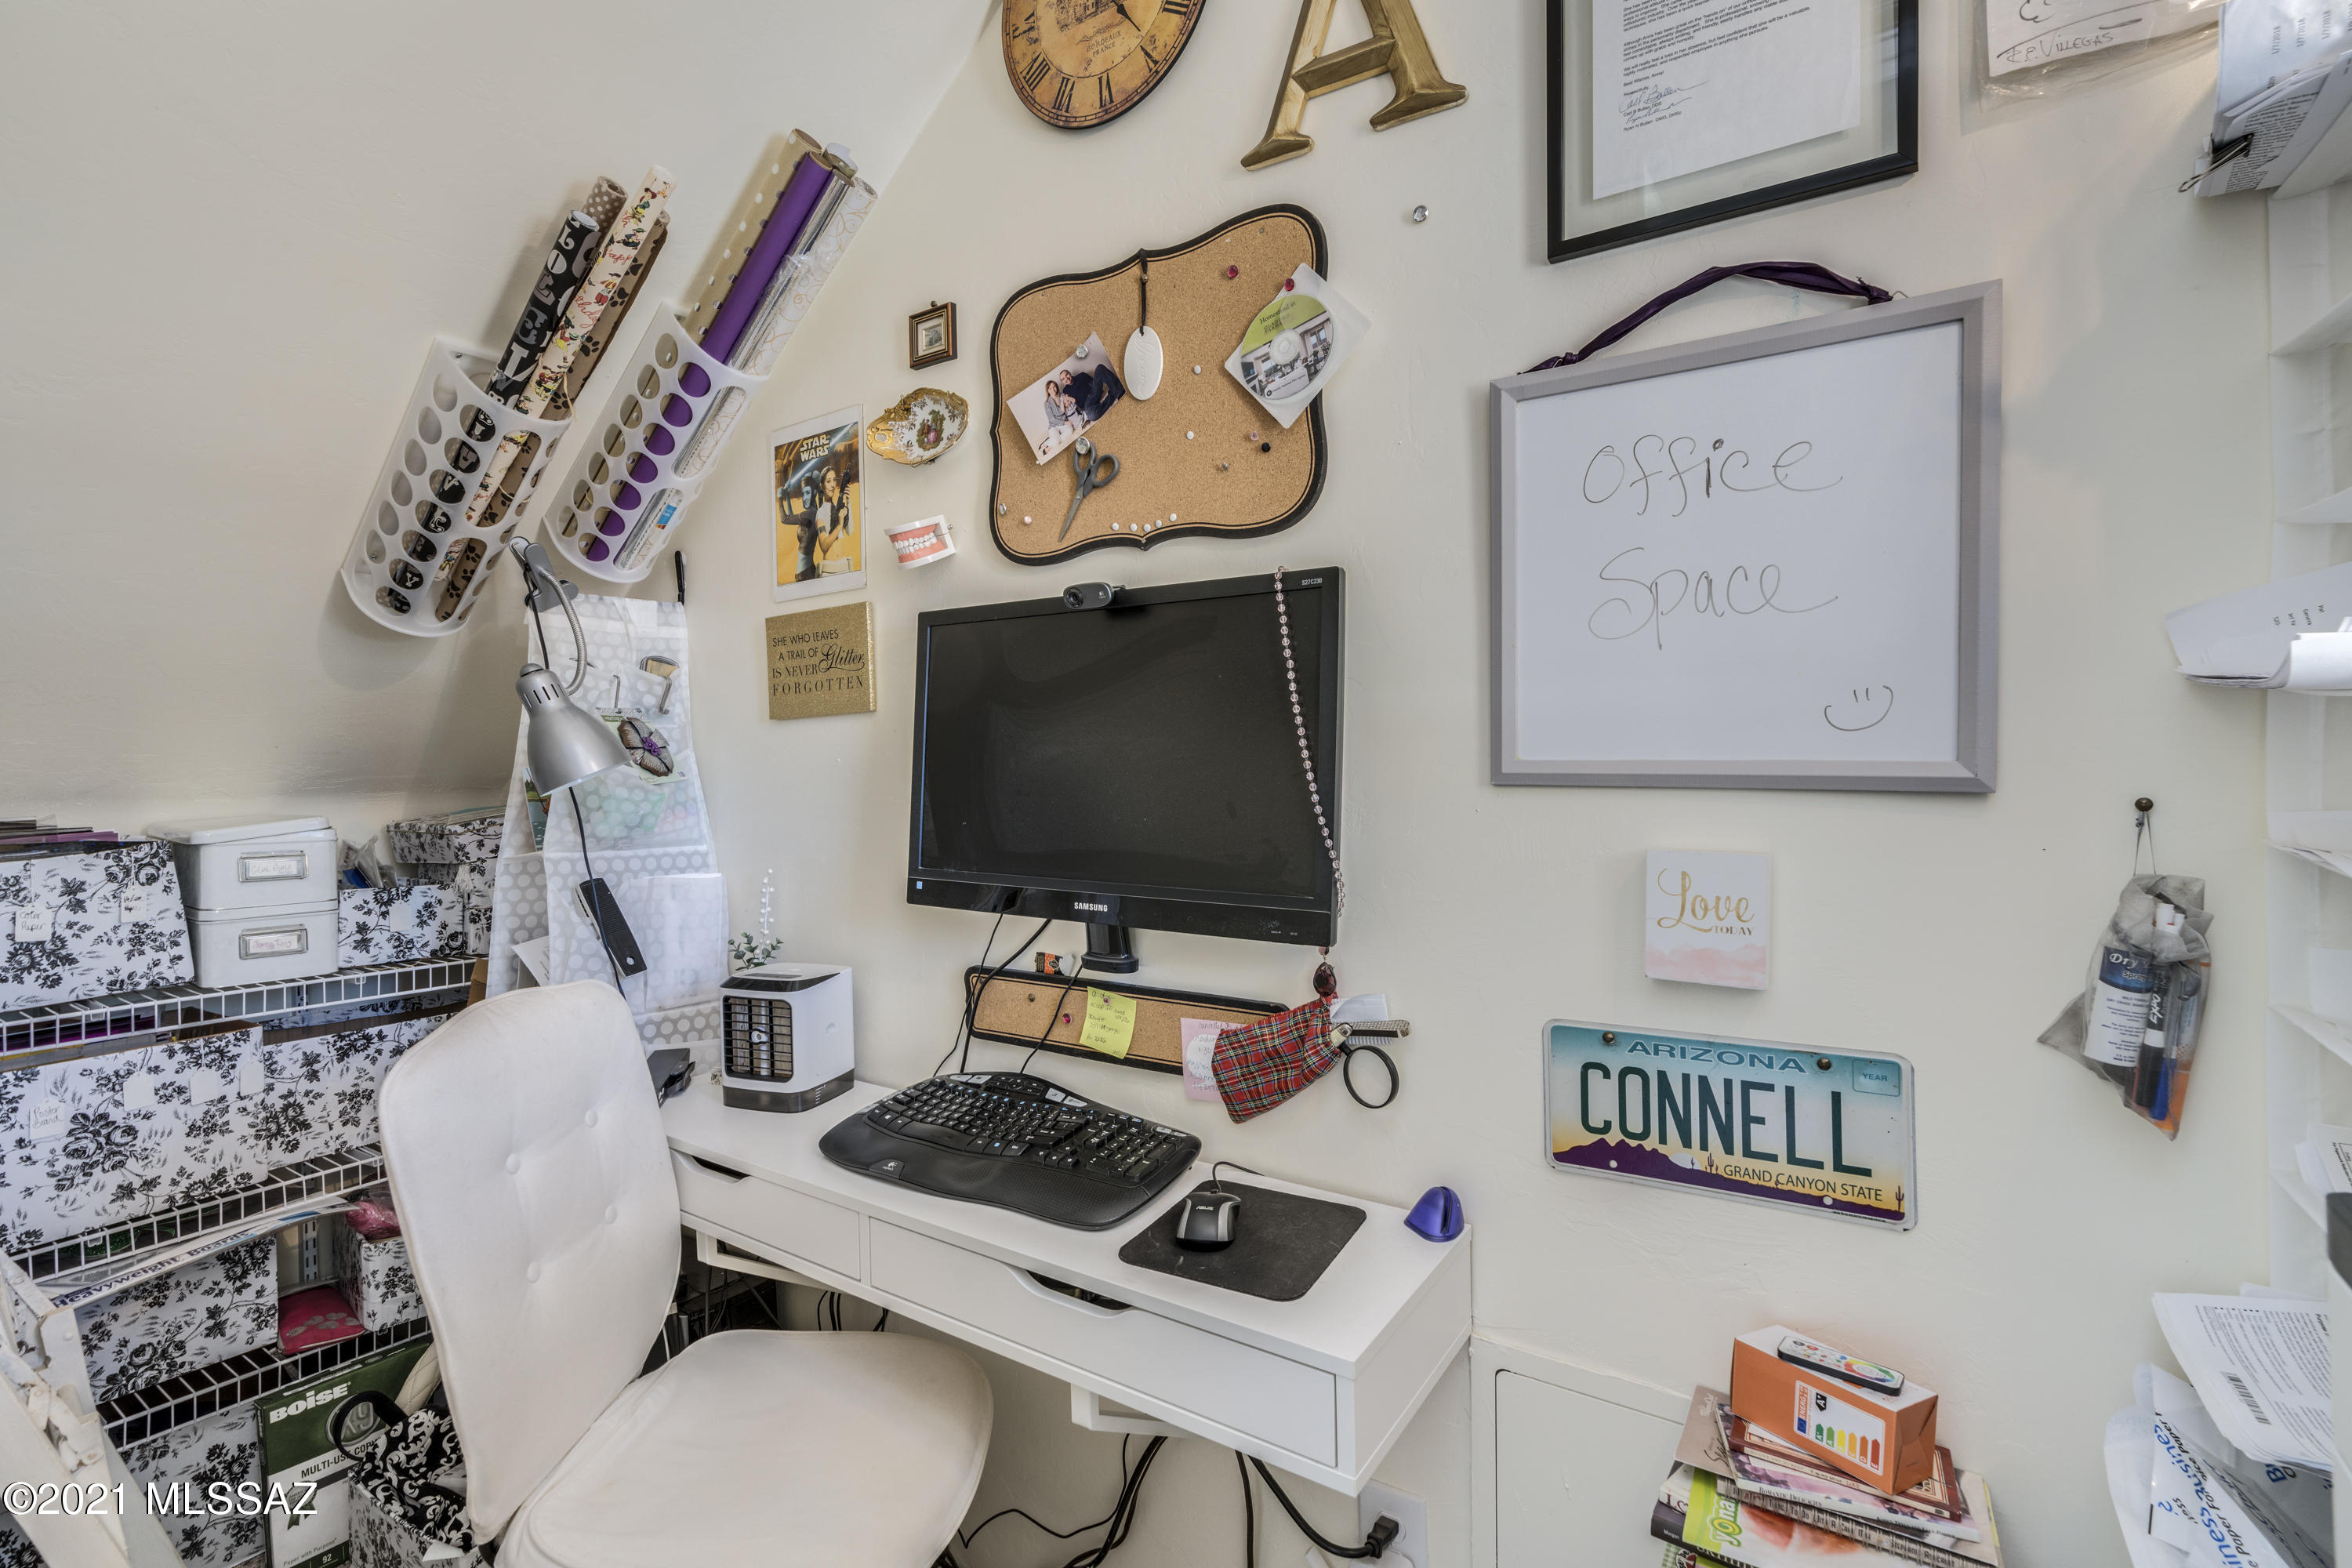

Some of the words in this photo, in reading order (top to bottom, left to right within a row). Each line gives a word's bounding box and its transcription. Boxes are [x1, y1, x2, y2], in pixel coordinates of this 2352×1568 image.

[1086, 30, 1121, 51] BORDEAUX
[1092, 41, 1116, 57] FRANCE
[800, 434, 829, 452] STAR
[800, 445, 830, 463] WARS
[1583, 434, 1842, 517] Office
[1588, 546, 1838, 651] Space
[772, 635, 787, 647] SHE
[789, 632, 811, 645] WHO
[813, 628, 839, 642] LEAVES
[779, 650, 784, 661] A
[787, 649, 806, 660] TRAIL
[808, 647, 818, 658] OF
[819, 643, 865, 673] Glitter
[772, 667, 781, 678] IS
[785, 663, 818, 678] NEVER
[773, 675, 863, 696] FORGOTTEN
[1074, 902, 1108, 912] SAMSUNG
[1657, 867, 1755, 933] Love
[1712, 925, 1754, 936] TODAY
[2109, 953, 2139, 969] Dry
[2150, 993, 2164, 1024] EXPO
[1626, 1040, 1806, 1073] ARIZONA
[1862, 1072, 1888, 1083] YEAR
[1580, 1061, 1872, 1178] CONNELL
[1724, 1163, 1773, 1183] GRAND
[1776, 1172, 1837, 1194] CANYON
[1840, 1183, 1883, 1202] STATE
[54, 1256, 183, 1308] Heavyweight
[188, 1230, 250, 1257] Boards
[301, 1451, 351, 1478] MULTI-US
[2216, 1514, 2251, 1556] Paper
[323, 1553, 332, 1564] 92
